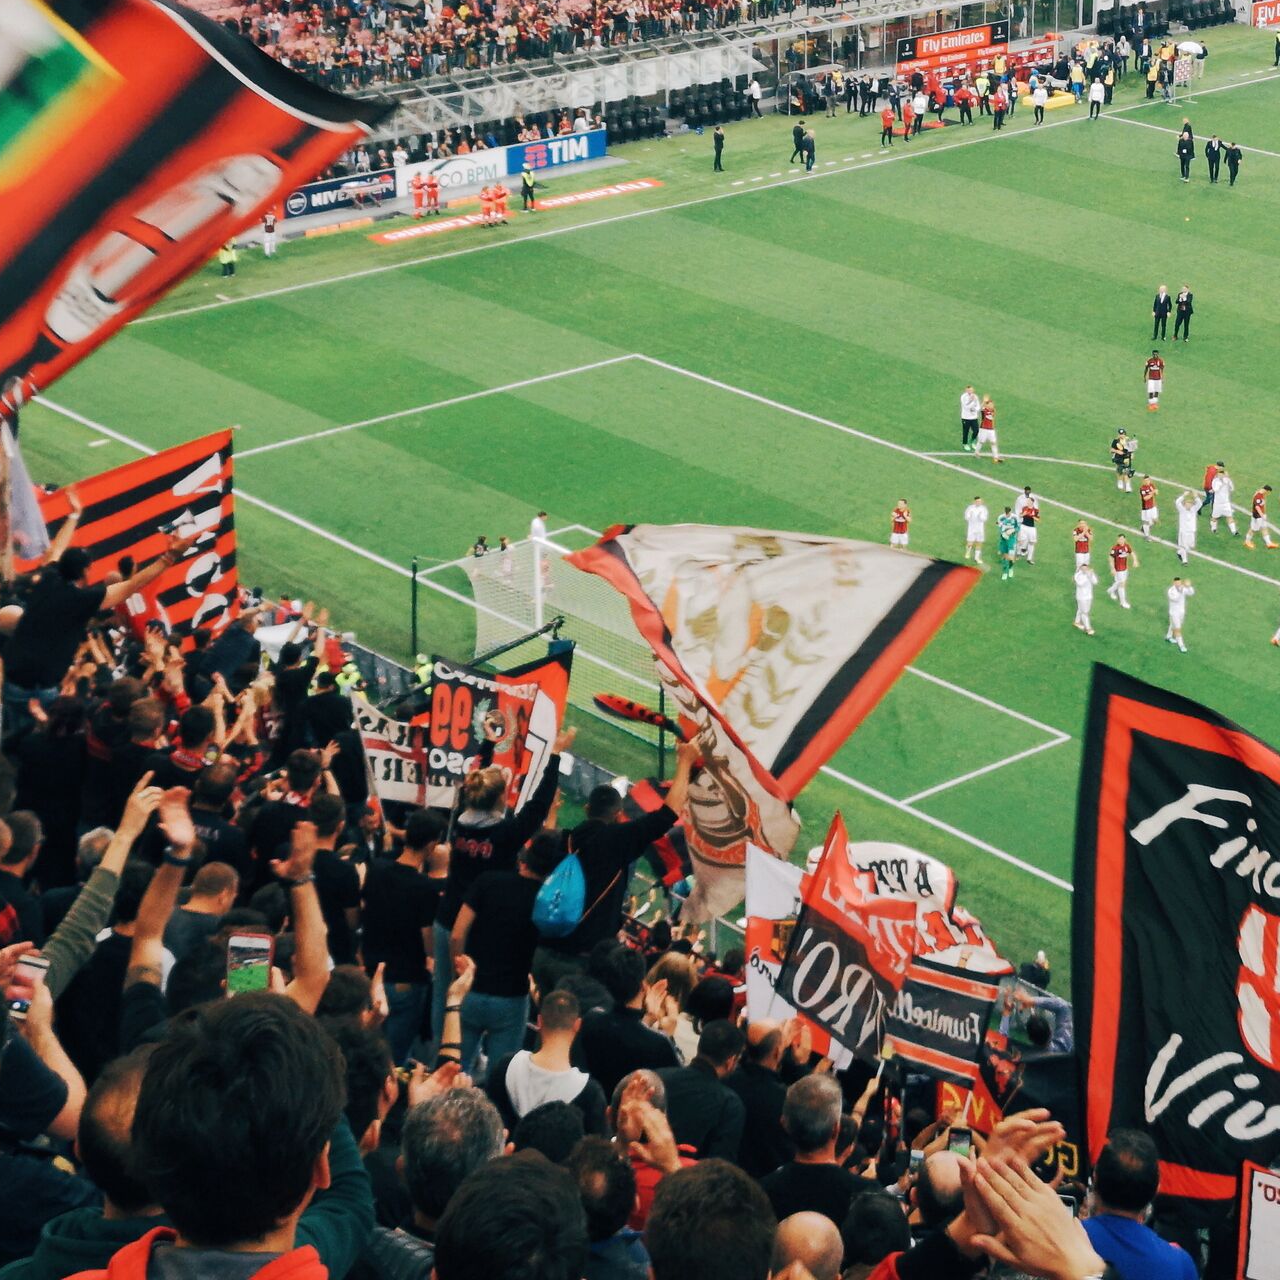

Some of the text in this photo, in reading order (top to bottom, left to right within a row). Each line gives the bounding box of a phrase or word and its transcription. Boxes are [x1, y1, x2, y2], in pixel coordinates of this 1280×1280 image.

[1257, 3, 1276, 22] Fly
[922, 31, 985, 53] Fly Emirates
[548, 136, 589, 165] TIM
[467, 164, 497, 183] BPM
